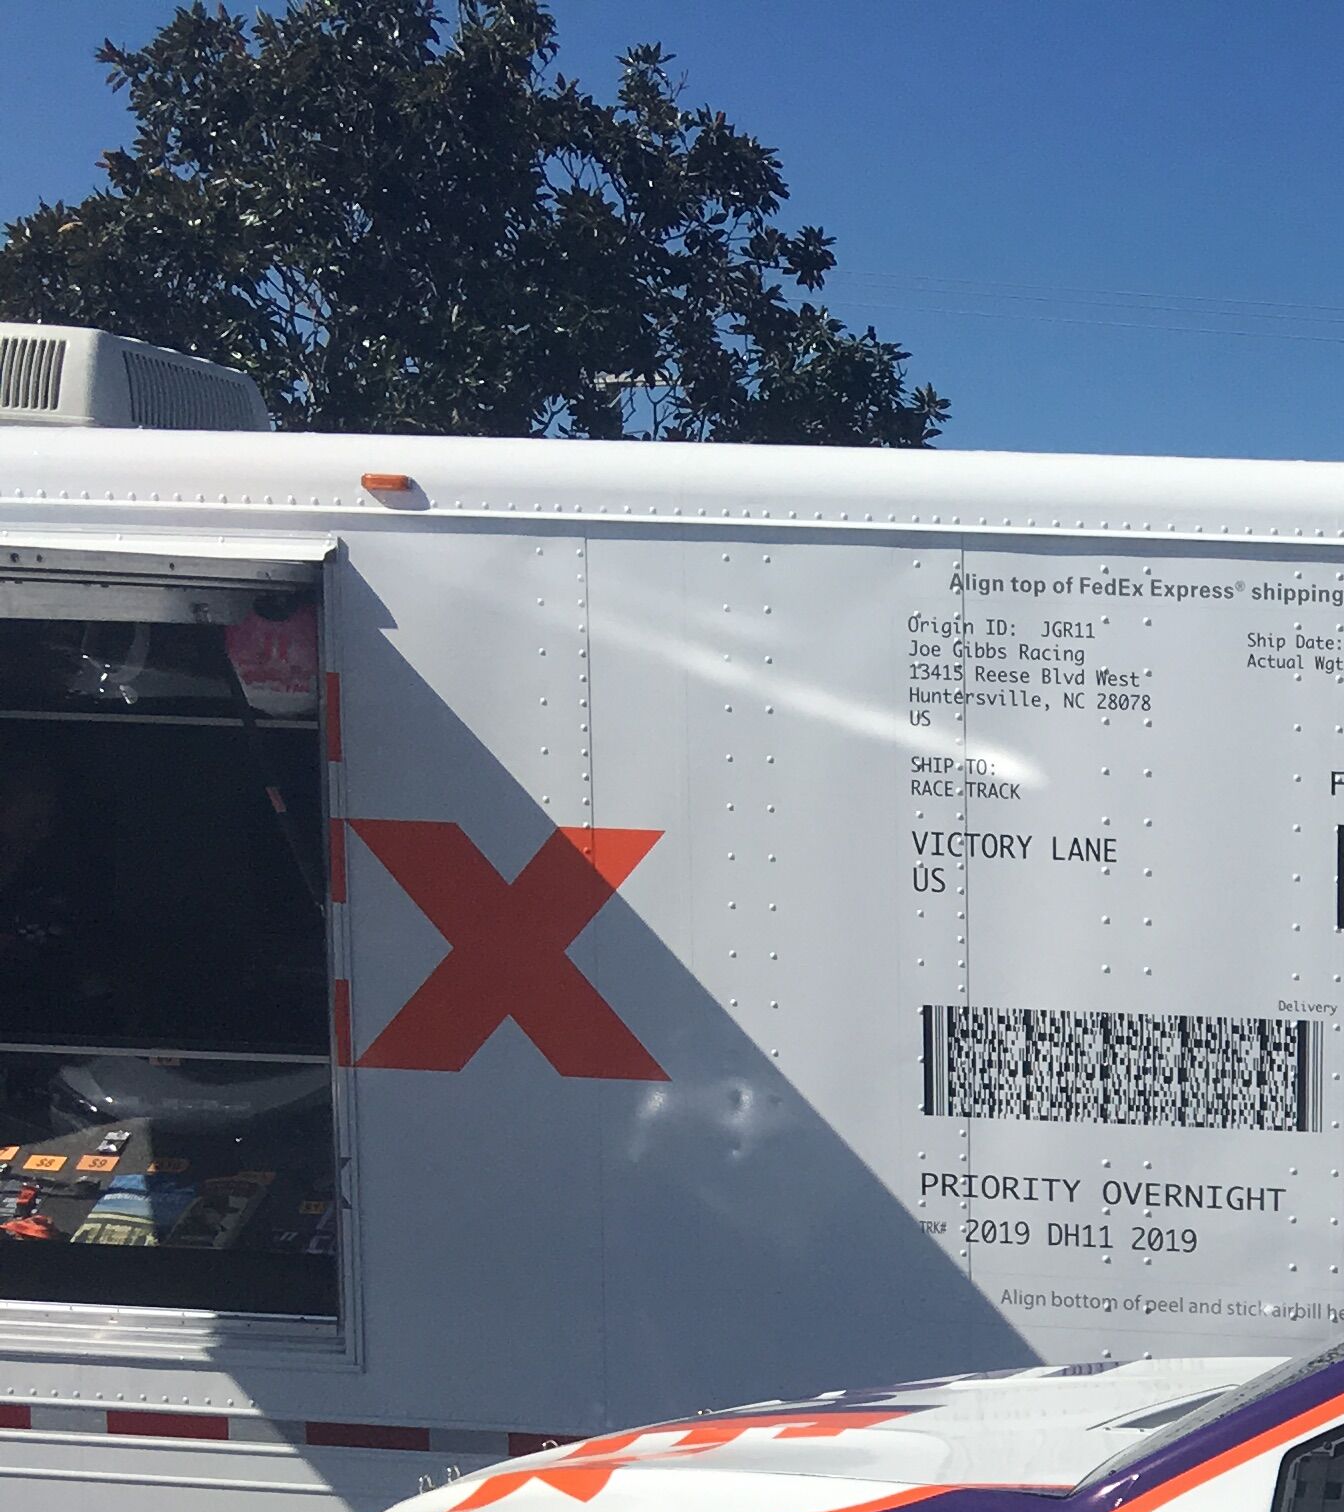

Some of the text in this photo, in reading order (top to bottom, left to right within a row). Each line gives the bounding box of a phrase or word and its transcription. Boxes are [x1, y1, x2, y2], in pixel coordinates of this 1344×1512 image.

[950, 573, 1004, 595] Align
[1011, 576, 1046, 597] top
[1053, 577, 1073, 594] of
[1079, 578, 1144, 597] FedEx
[1251, 583, 1343, 606] shipping
[908, 616, 1095, 639] Origin ID: JGR11
[909, 640, 1085, 665] Joe Gibbs Racing
[1247, 633, 1286, 650] Ship
[1296, 635, 1342, 650] Date:
[1247, 654, 1304, 669] Actual
[909, 664, 1140, 687] 13415 Reese Blvd West
[910, 687, 1151, 711] Huntersville, NC 28078
[910, 711, 931, 726] US
[911, 756, 995, 776] SHIP TO:
[911, 780, 1021, 799] RACE TRACK
[912, 831, 1117, 862] VICTORY LANE
[913, 867, 946, 892] US
[1279, 1000, 1337, 1016] Delivery
[921, 1172, 1287, 1212] PRIORITY OVERNIGHT
[920, 1219, 1198, 1253] TRK# 2019 DH11 2019
[1001, 1289, 1046, 1311] Align
[1051, 1290, 1117, 1311] bottom
[1123, 1294, 1143, 1311] of
[1146, 1296, 1184, 1317] peel
[1189, 1299, 1221, 1315] and
[1227, 1300, 1265, 1317] stick
[1271, 1303, 1322, 1319] airbill
